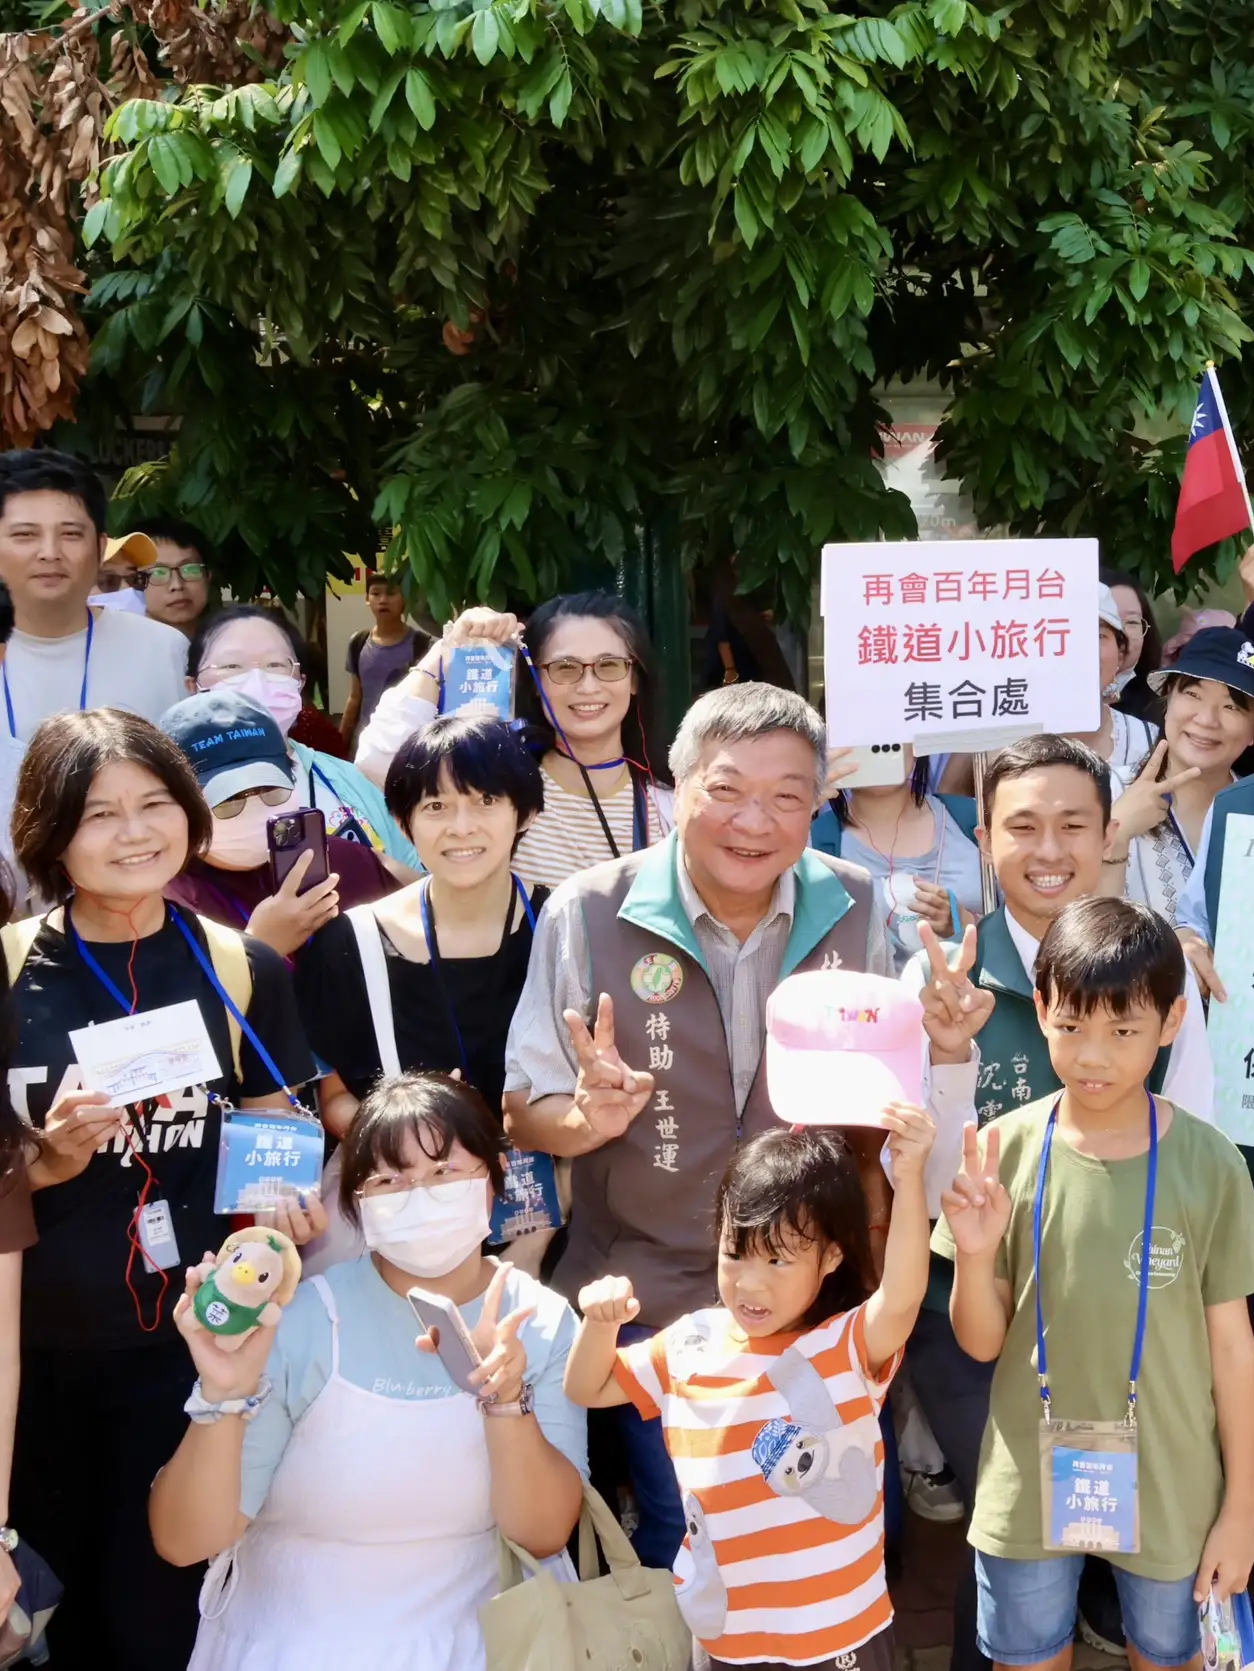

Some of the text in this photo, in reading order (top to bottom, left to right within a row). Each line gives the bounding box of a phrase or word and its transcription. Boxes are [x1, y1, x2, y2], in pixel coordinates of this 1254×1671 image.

[861, 567, 1066, 607] 再會百年月台
[857, 617, 1071, 666] 鐵道小旅行
[903, 677, 1030, 722] 集合處
[190, 727, 266, 752] TEAM TAIWAN
[644, 1011, 675, 1072] 特助
[652, 1088, 681, 1174] 王世運
[244, 1149, 301, 1167] 小旅行
[1065, 1493, 1118, 1512] 小旅行
